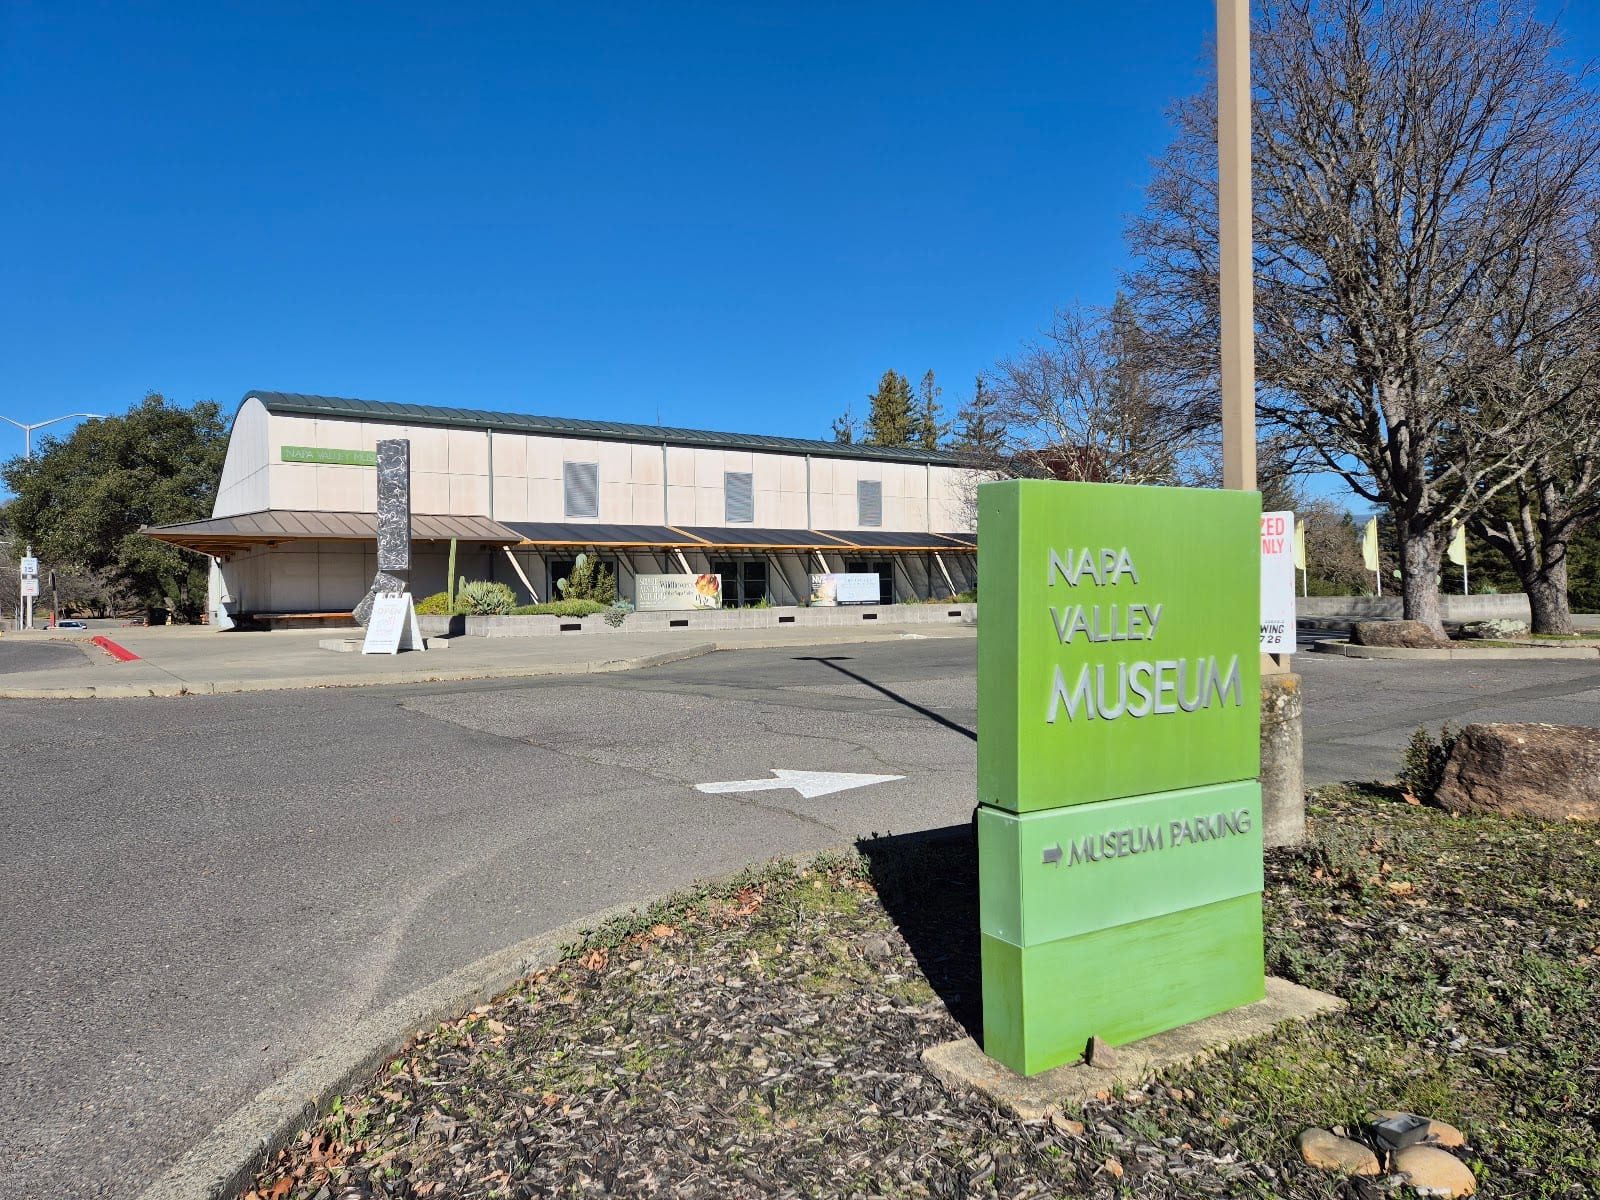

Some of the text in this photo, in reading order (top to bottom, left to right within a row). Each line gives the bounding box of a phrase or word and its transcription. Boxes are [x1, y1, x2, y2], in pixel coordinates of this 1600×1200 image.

[286, 449, 376, 462] NAPA VALLEY MUS
[1262, 539, 1285, 554] NLY
[1048, 546, 1139, 588] NAPA
[1048, 603, 1164, 645] VALLEY
[1260, 624, 1285, 634] WING
[1259, 635, 1282, 644] 726
[1046, 654, 1243, 724] MUSEUM
[1067, 809, 1252, 867] MUSEUM PARKING
